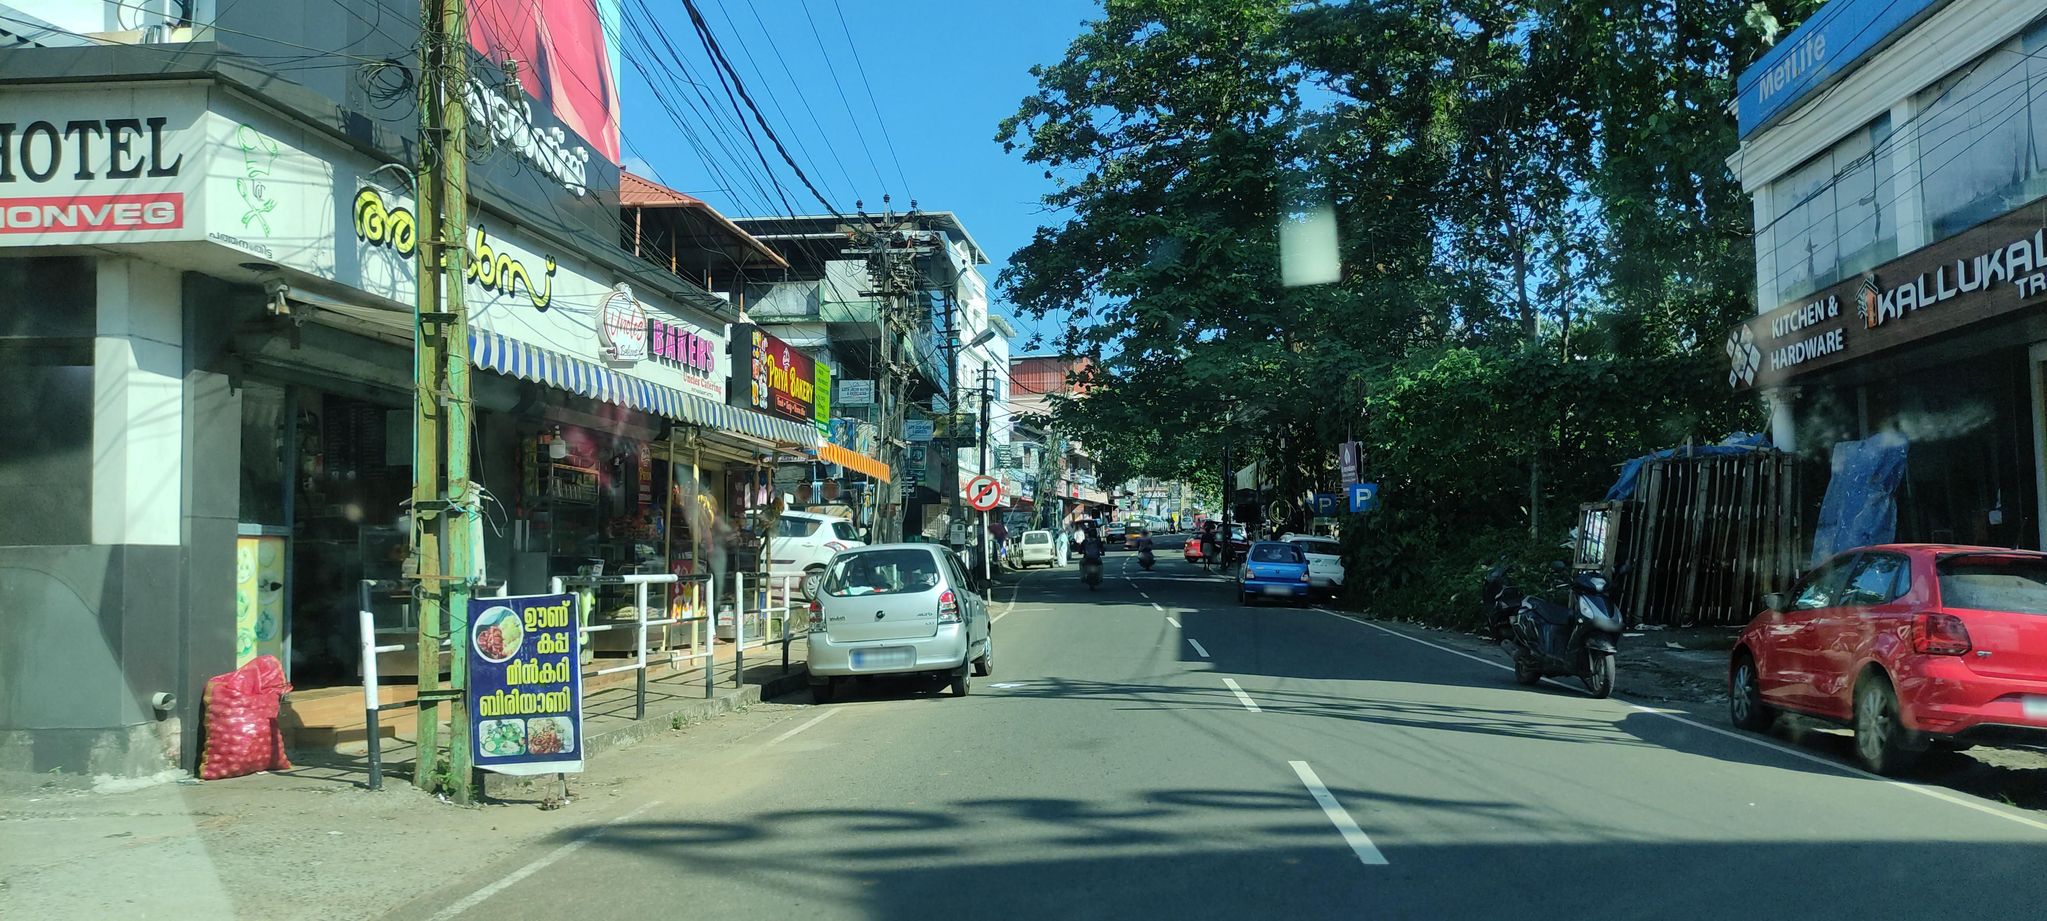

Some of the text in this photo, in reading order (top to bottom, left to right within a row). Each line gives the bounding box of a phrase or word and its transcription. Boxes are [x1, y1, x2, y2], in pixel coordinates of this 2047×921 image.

[1758, 31, 1826, 104] MetLife
[0, 202, 175, 228] ONVEG
[1771, 295, 1839, 339] KITCHEN &
[653, 319, 715, 373] BAKERS
[1770, 328, 1844, 371] HARDWARE
[767, 354, 789, 394] PRIYA
[1319, 497, 1332, 514] P
[1356, 488, 1372, 508] P
[523, 600, 571, 633] ഊണ്
[506, 656, 570, 686] മീൻകറി
[479, 686, 572, 717] ബിരിയാണി
